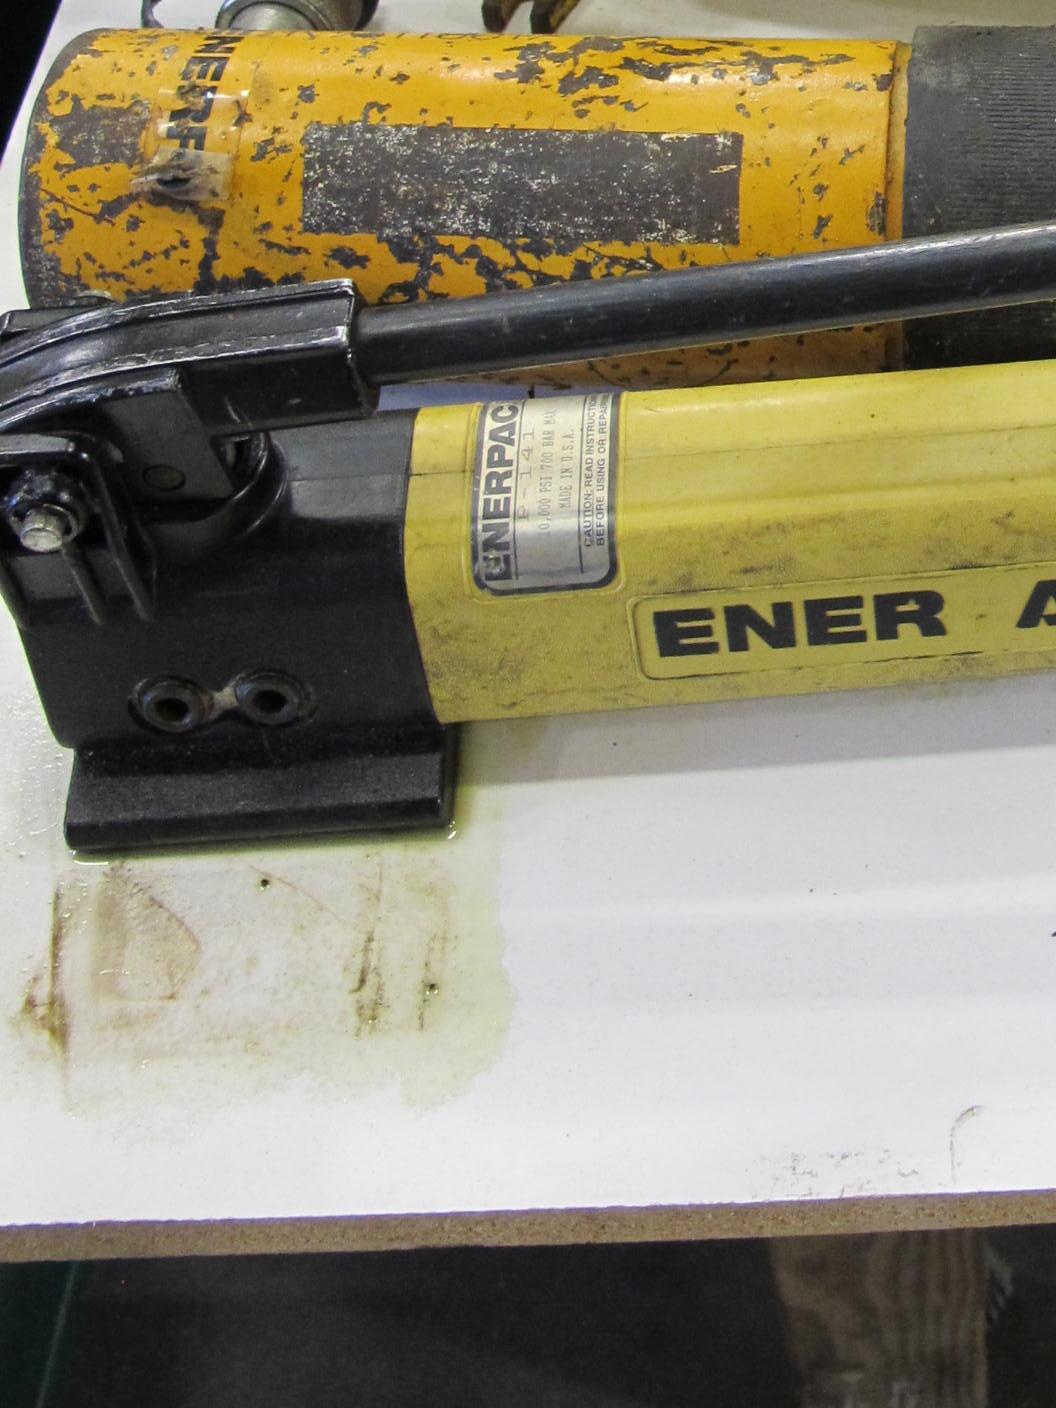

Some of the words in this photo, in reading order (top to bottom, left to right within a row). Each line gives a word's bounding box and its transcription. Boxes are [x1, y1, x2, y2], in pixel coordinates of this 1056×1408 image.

[542, 430, 555, 447] BAR
[597, 438, 607, 455] OR
[541, 451, 554, 471] 700
[560, 467, 574, 480] IN
[584, 457, 594, 488] READ
[517, 431, 534, 520] P-141
[539, 475, 553, 494] PSI
[596, 458, 606, 492] USING
[481, 404, 520, 581] ENERPAC
[559, 485, 573, 509] MADE
[583, 488, 594, 549] CAUTION:
[595, 495, 606, 547] BEFORE
